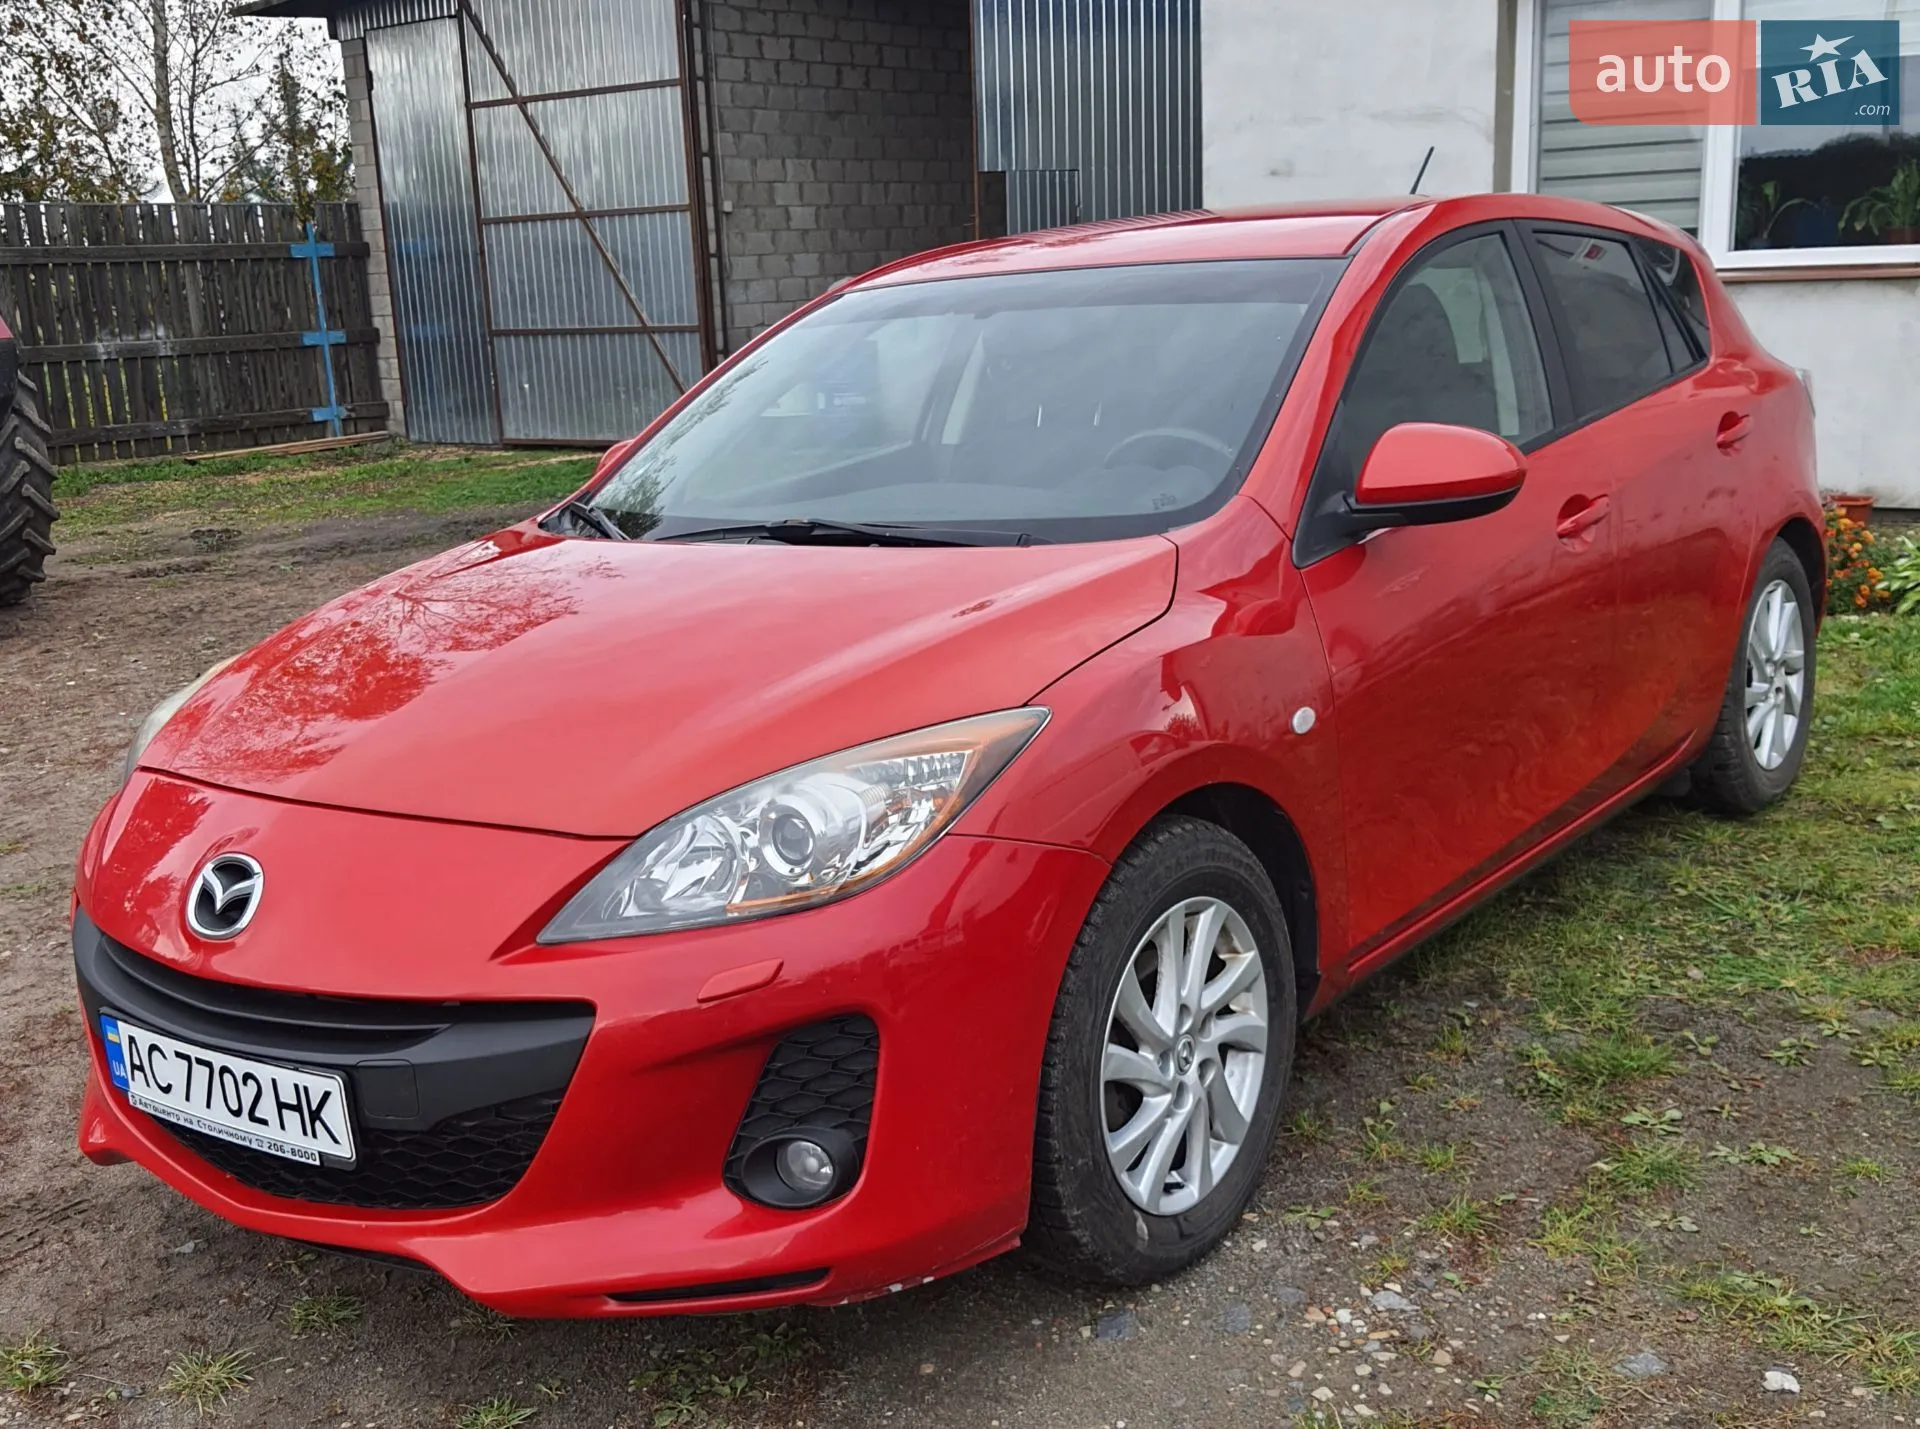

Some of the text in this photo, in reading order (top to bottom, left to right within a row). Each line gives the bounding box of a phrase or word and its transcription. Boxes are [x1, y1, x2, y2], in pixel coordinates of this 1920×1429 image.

[112, 1061, 128, 1079] UA
[183, 1115, 194, 1126] на
[267, 1141, 317, 1162] 206-8000
